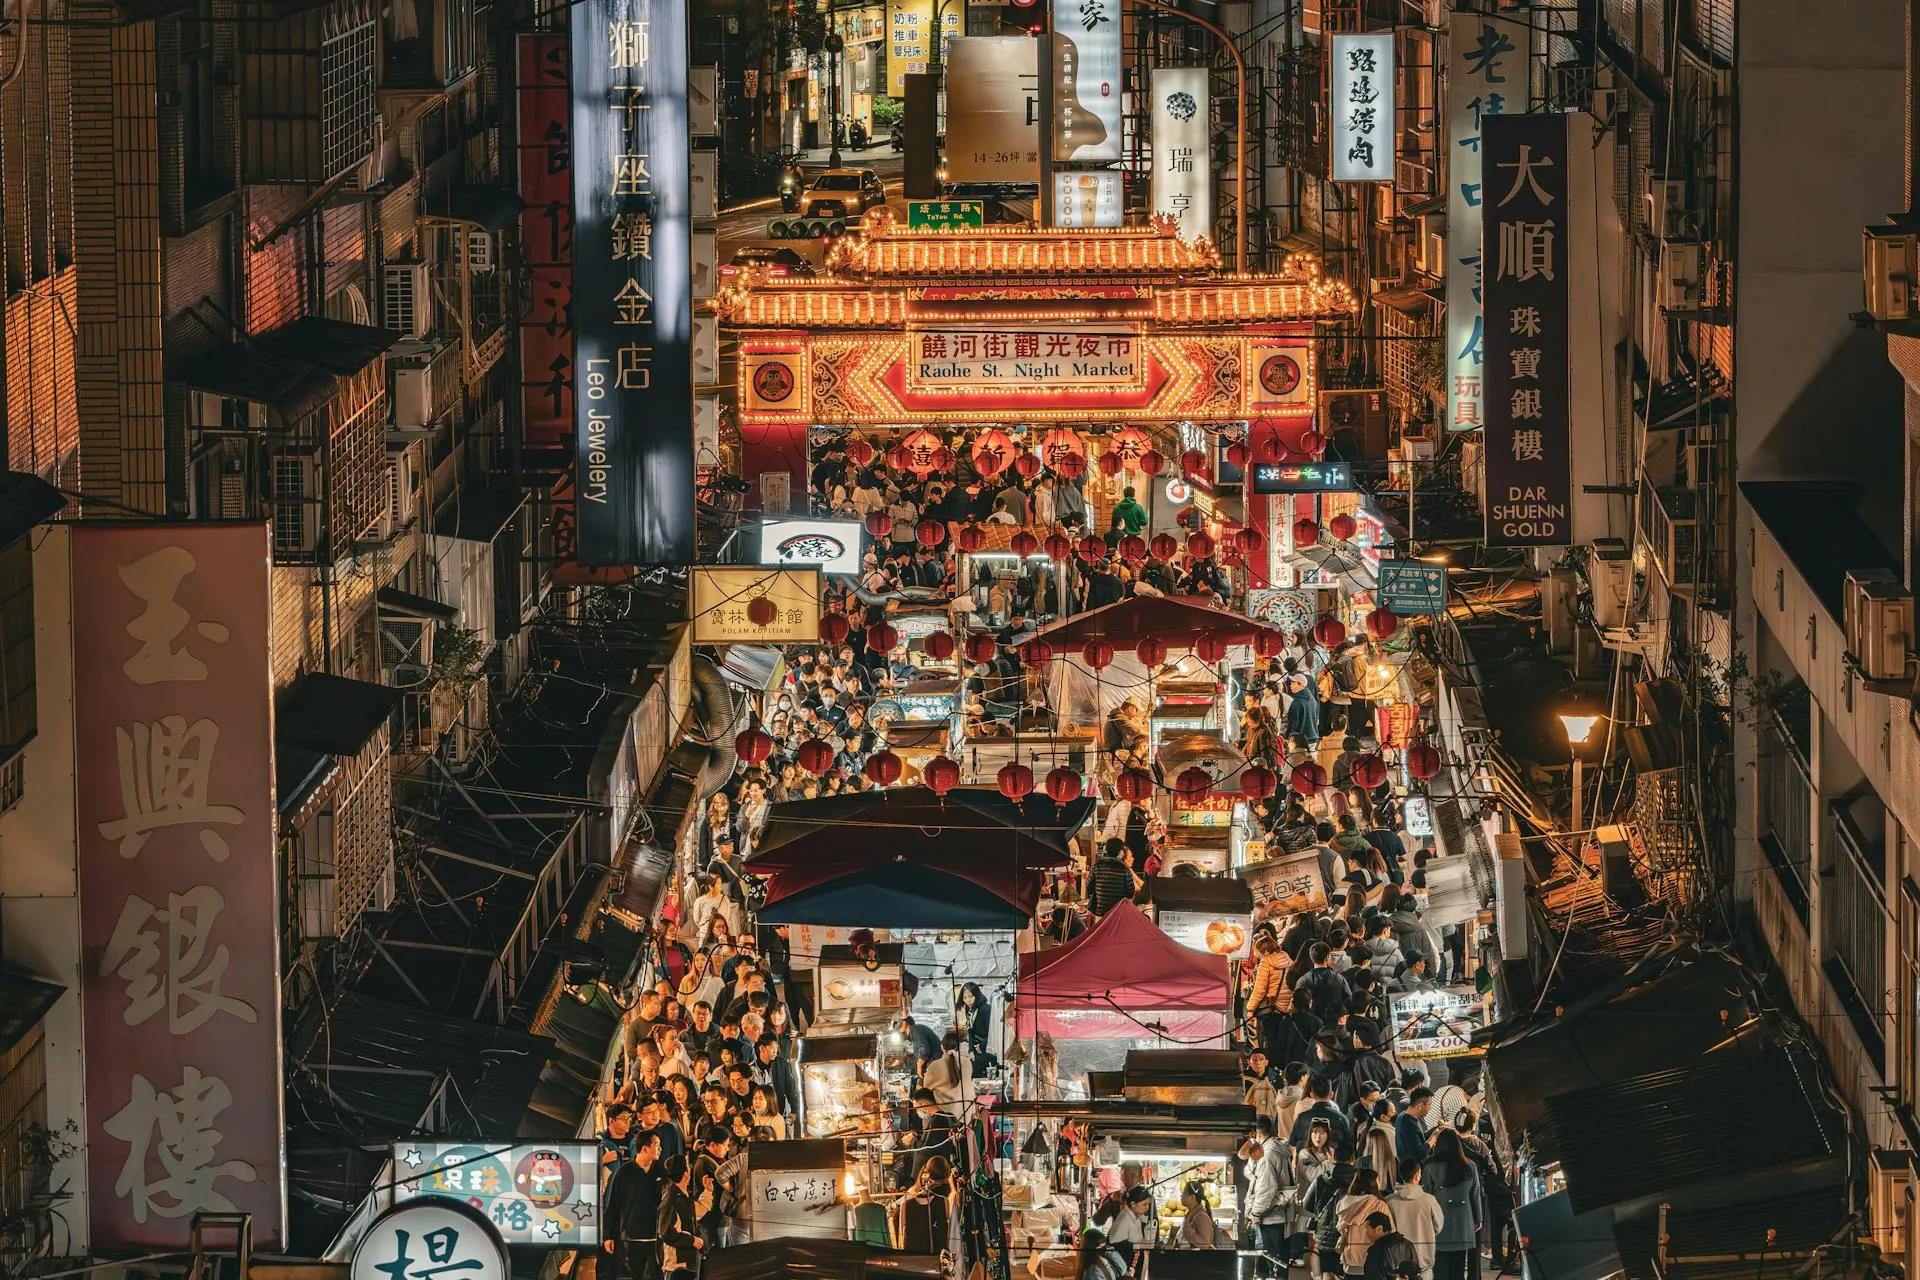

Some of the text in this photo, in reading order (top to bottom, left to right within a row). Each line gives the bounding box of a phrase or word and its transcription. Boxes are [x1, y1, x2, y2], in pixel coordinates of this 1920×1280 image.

[1346, 48, 1380, 169] 路邊烤肉
[609, 20, 653, 390] 獅子座鑽金店
[920, 203, 971, 214] 塔悠路
[1496, 145, 1555, 283] 大順
[920, 333, 1131, 360] 饒河街觀光夜市
[919, 362, 1134, 381] Raohe St. Night Market
[1509, 307, 1544, 463] 珠寶銀樓
[1454, 375, 1481, 425] 玩具
[583, 358, 612, 504] Leo Jewelery
[1509, 486, 1548, 501] DAR
[1493, 503, 1565, 520] SHUENN
[1503, 522, 1555, 538] GOLD
[722, 627, 792, 635] POLAM KOPITIAM
